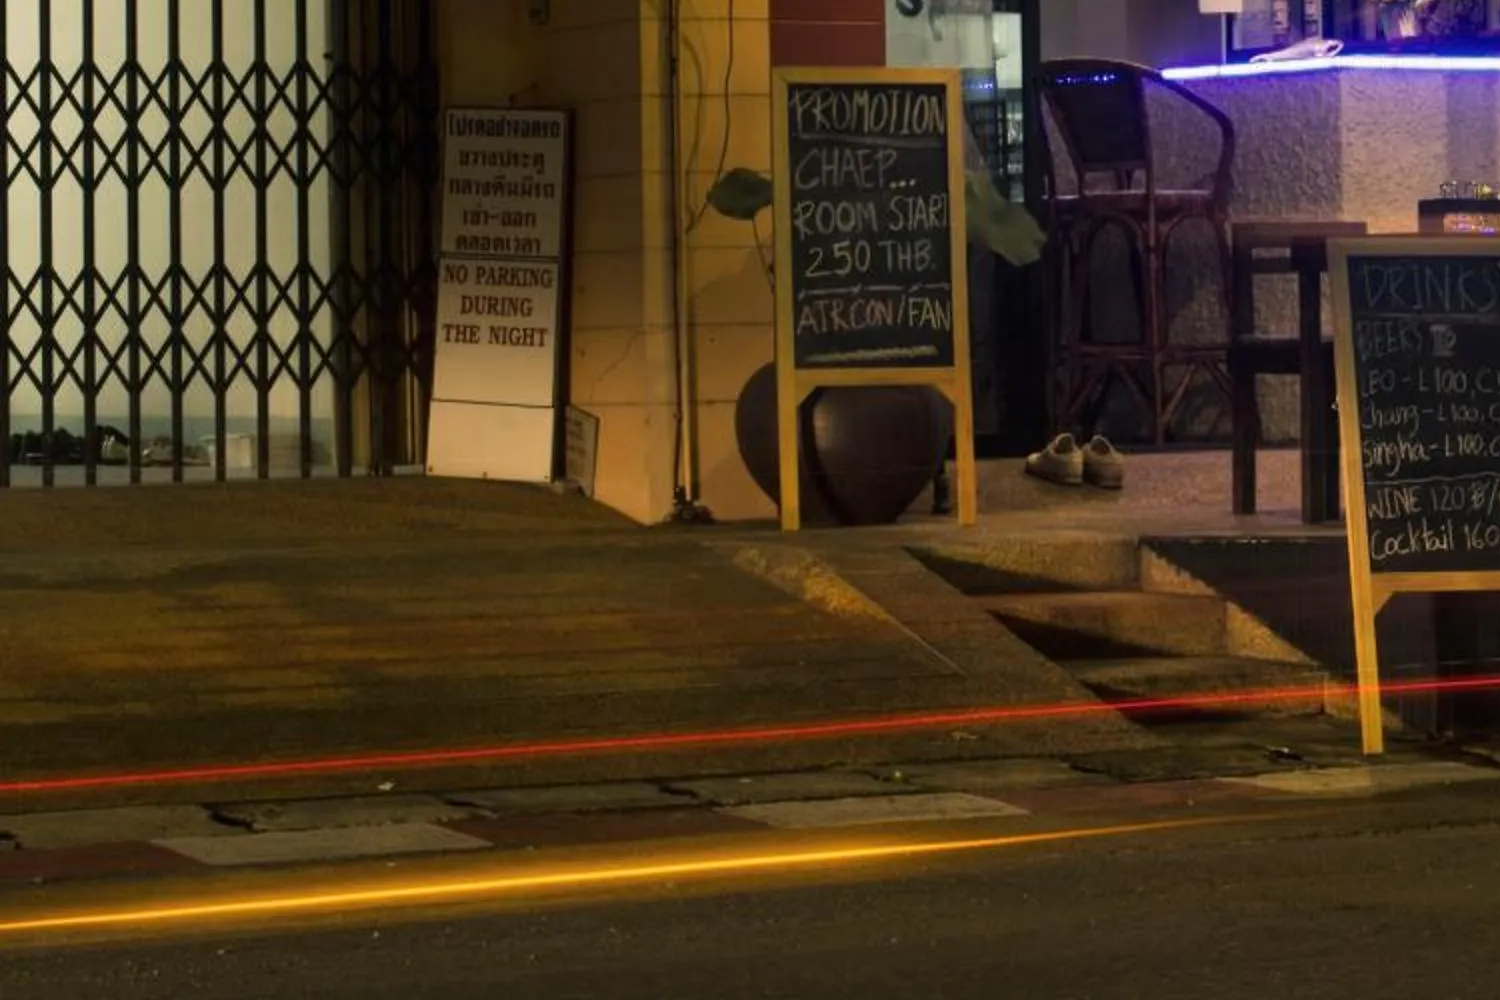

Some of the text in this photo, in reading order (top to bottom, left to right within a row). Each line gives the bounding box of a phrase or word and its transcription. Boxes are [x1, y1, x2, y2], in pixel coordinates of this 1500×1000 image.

[791, 87, 946, 136] PROMOTION
[794, 198, 879, 240] ROOM
[443, 263, 553, 288] NO PARKING
[804, 240, 871, 277] 250
[460, 294, 535, 318] DURING
[1358, 262, 1500, 314] DRINKS
[442, 323, 549, 348] THE NIGHT
[1368, 484, 1423, 520] WINE
[1371, 518, 1455, 561] Cocktail
